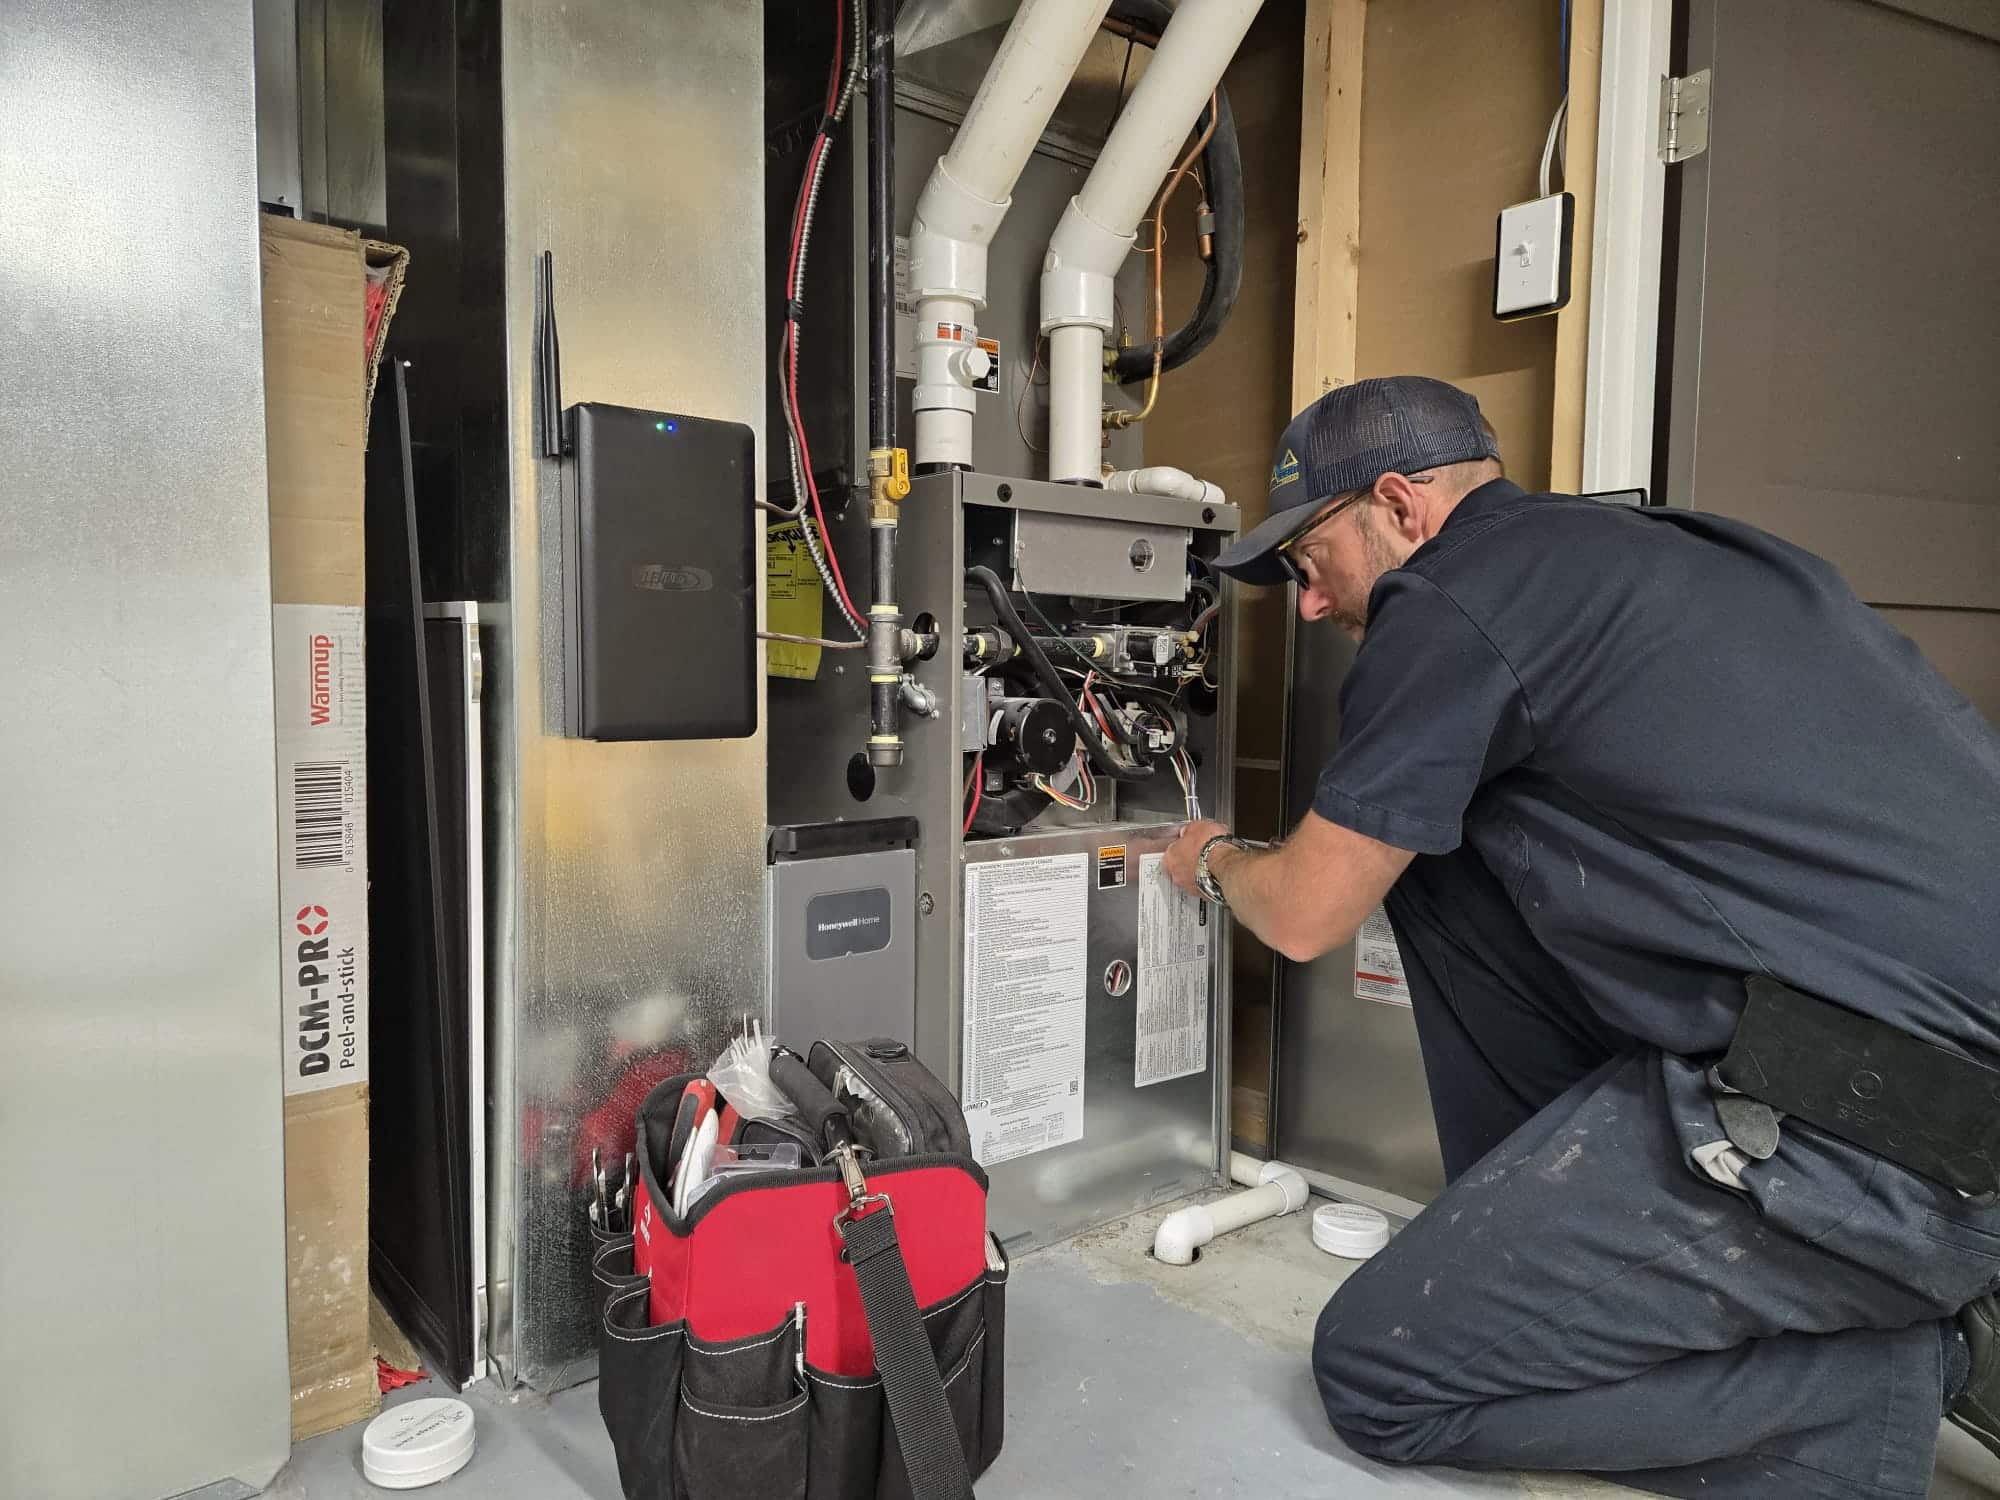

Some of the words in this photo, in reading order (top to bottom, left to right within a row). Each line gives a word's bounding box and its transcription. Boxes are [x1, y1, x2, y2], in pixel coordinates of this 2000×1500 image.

[310, 633, 335, 726] Warmup
[344, 770, 354, 803] 015404
[344, 822, 354, 856] 815846
[818, 918, 858, 932] Honeywell
[858, 916, 880, 926] Home
[336, 946, 355, 1069] Peel-and-stick
